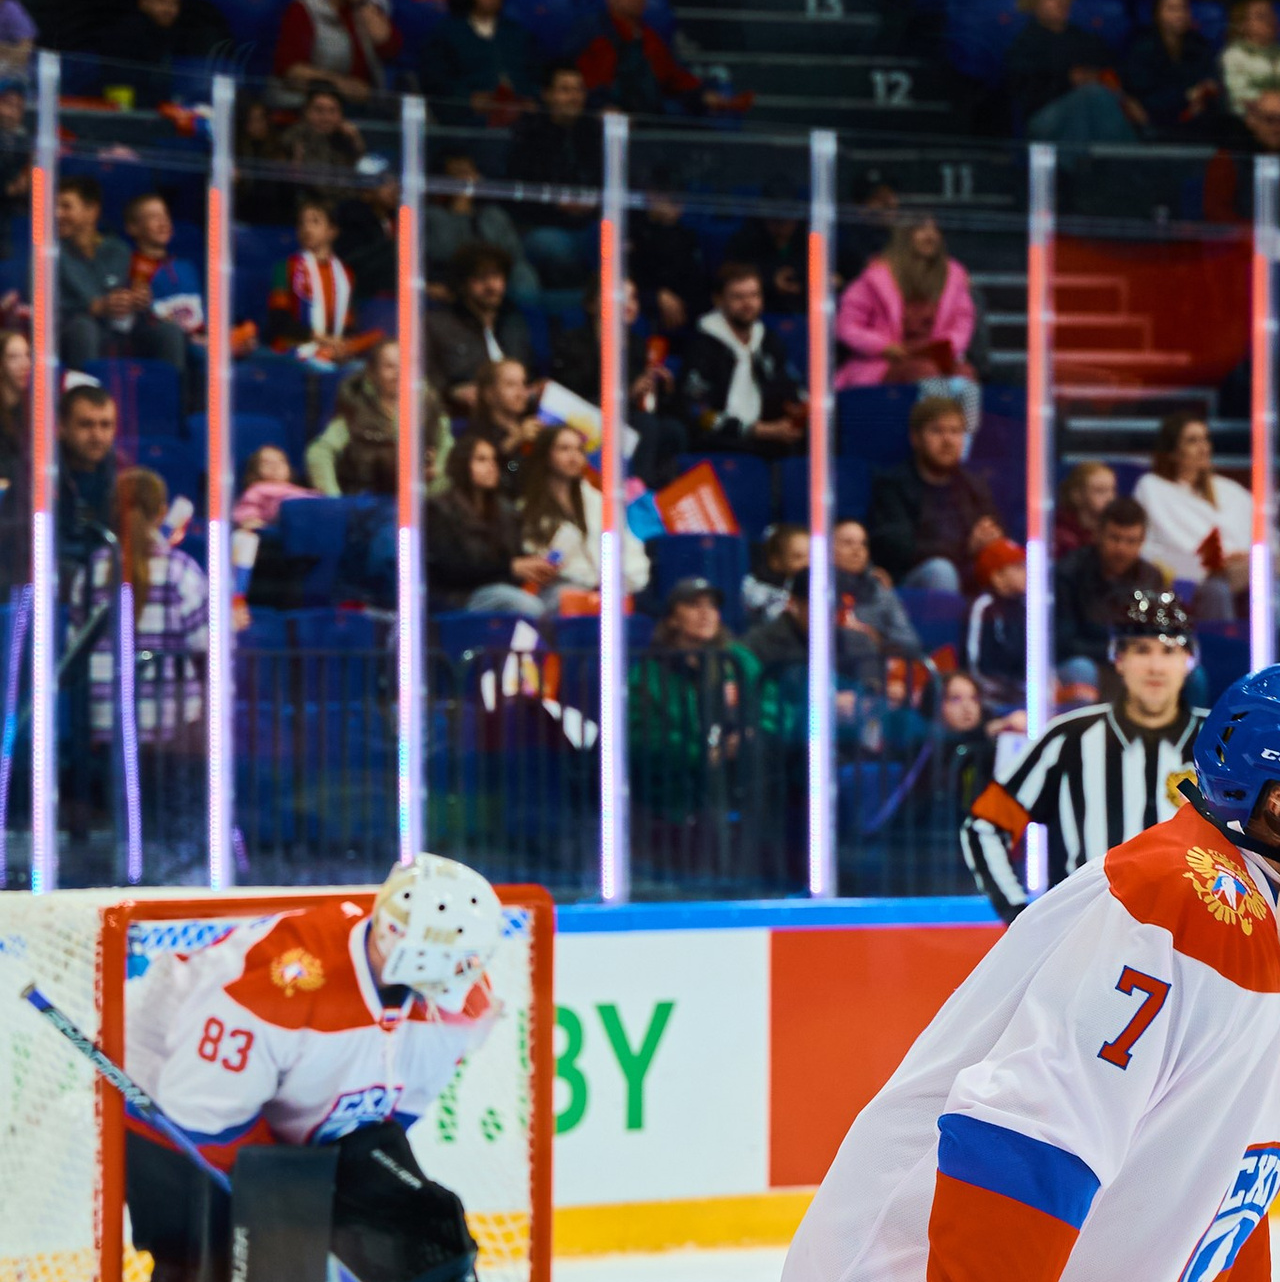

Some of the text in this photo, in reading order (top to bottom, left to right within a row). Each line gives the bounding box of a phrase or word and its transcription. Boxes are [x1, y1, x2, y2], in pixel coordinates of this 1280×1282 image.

[870, 69, 913, 106] 12
[939, 163, 974, 199] 11
[1097, 964, 1172, 1071] 7
[197, 1016, 255, 1075] 83
